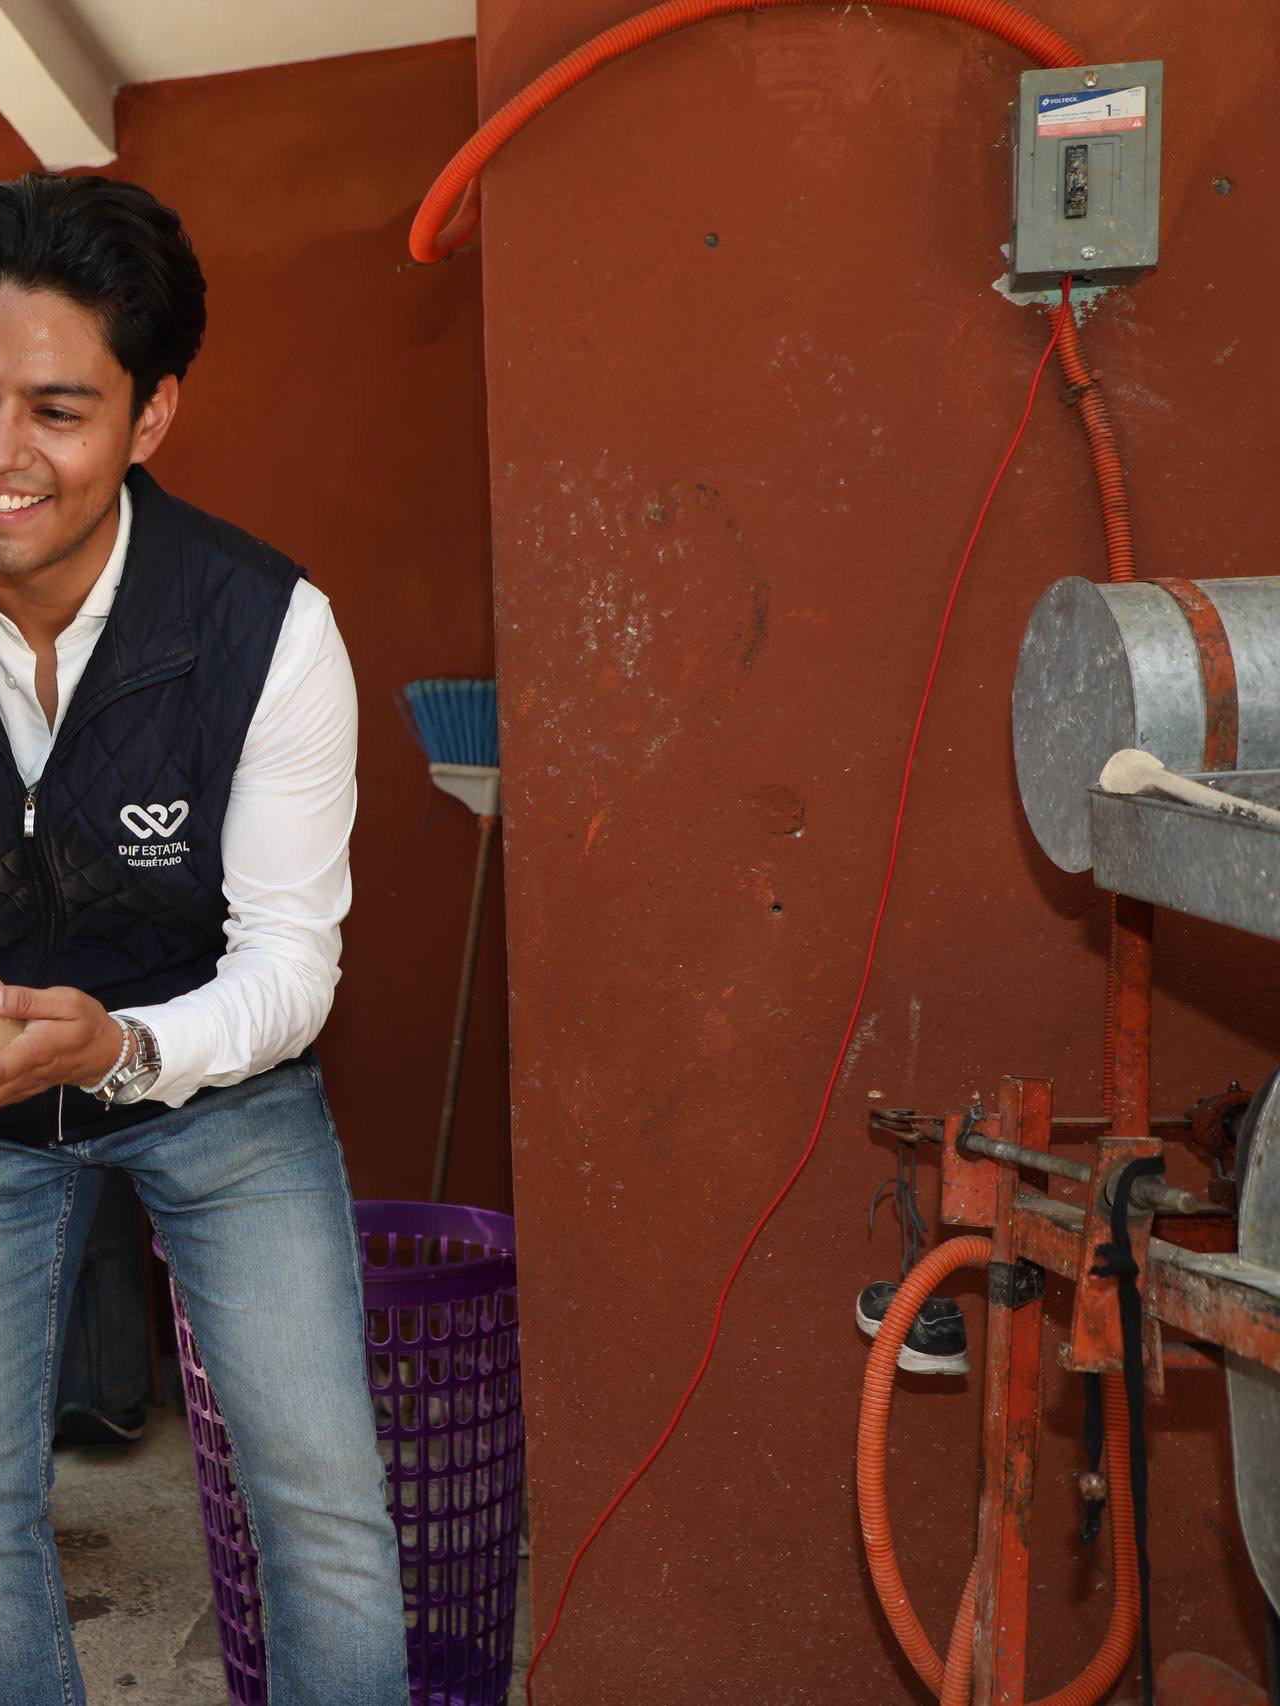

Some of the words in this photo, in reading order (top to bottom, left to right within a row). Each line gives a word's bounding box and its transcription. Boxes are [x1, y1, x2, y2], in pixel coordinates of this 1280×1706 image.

[118, 845, 140, 856] DIF
[142, 841, 190, 856] ESTATAL
[127, 856, 182, 867] QUERÉTARO
